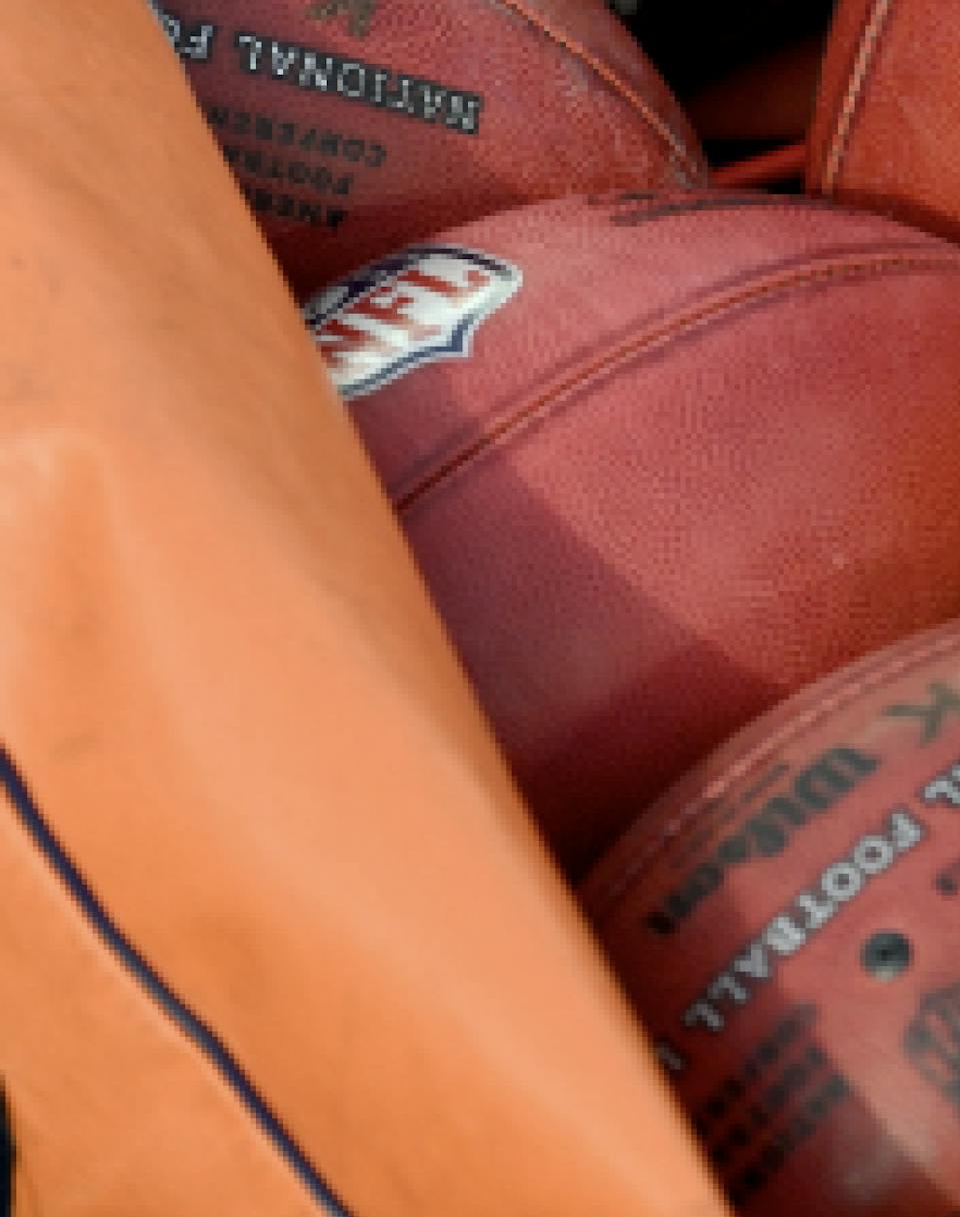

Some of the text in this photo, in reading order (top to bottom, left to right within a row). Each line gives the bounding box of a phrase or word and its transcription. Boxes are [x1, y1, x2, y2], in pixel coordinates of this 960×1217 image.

[235, 33, 480, 134] NATIONAL
[206, 105, 387, 169] CONFEREN
[222, 144, 354, 196] FOOTBA
[681, 806, 923, 1033] FOOTBALL
